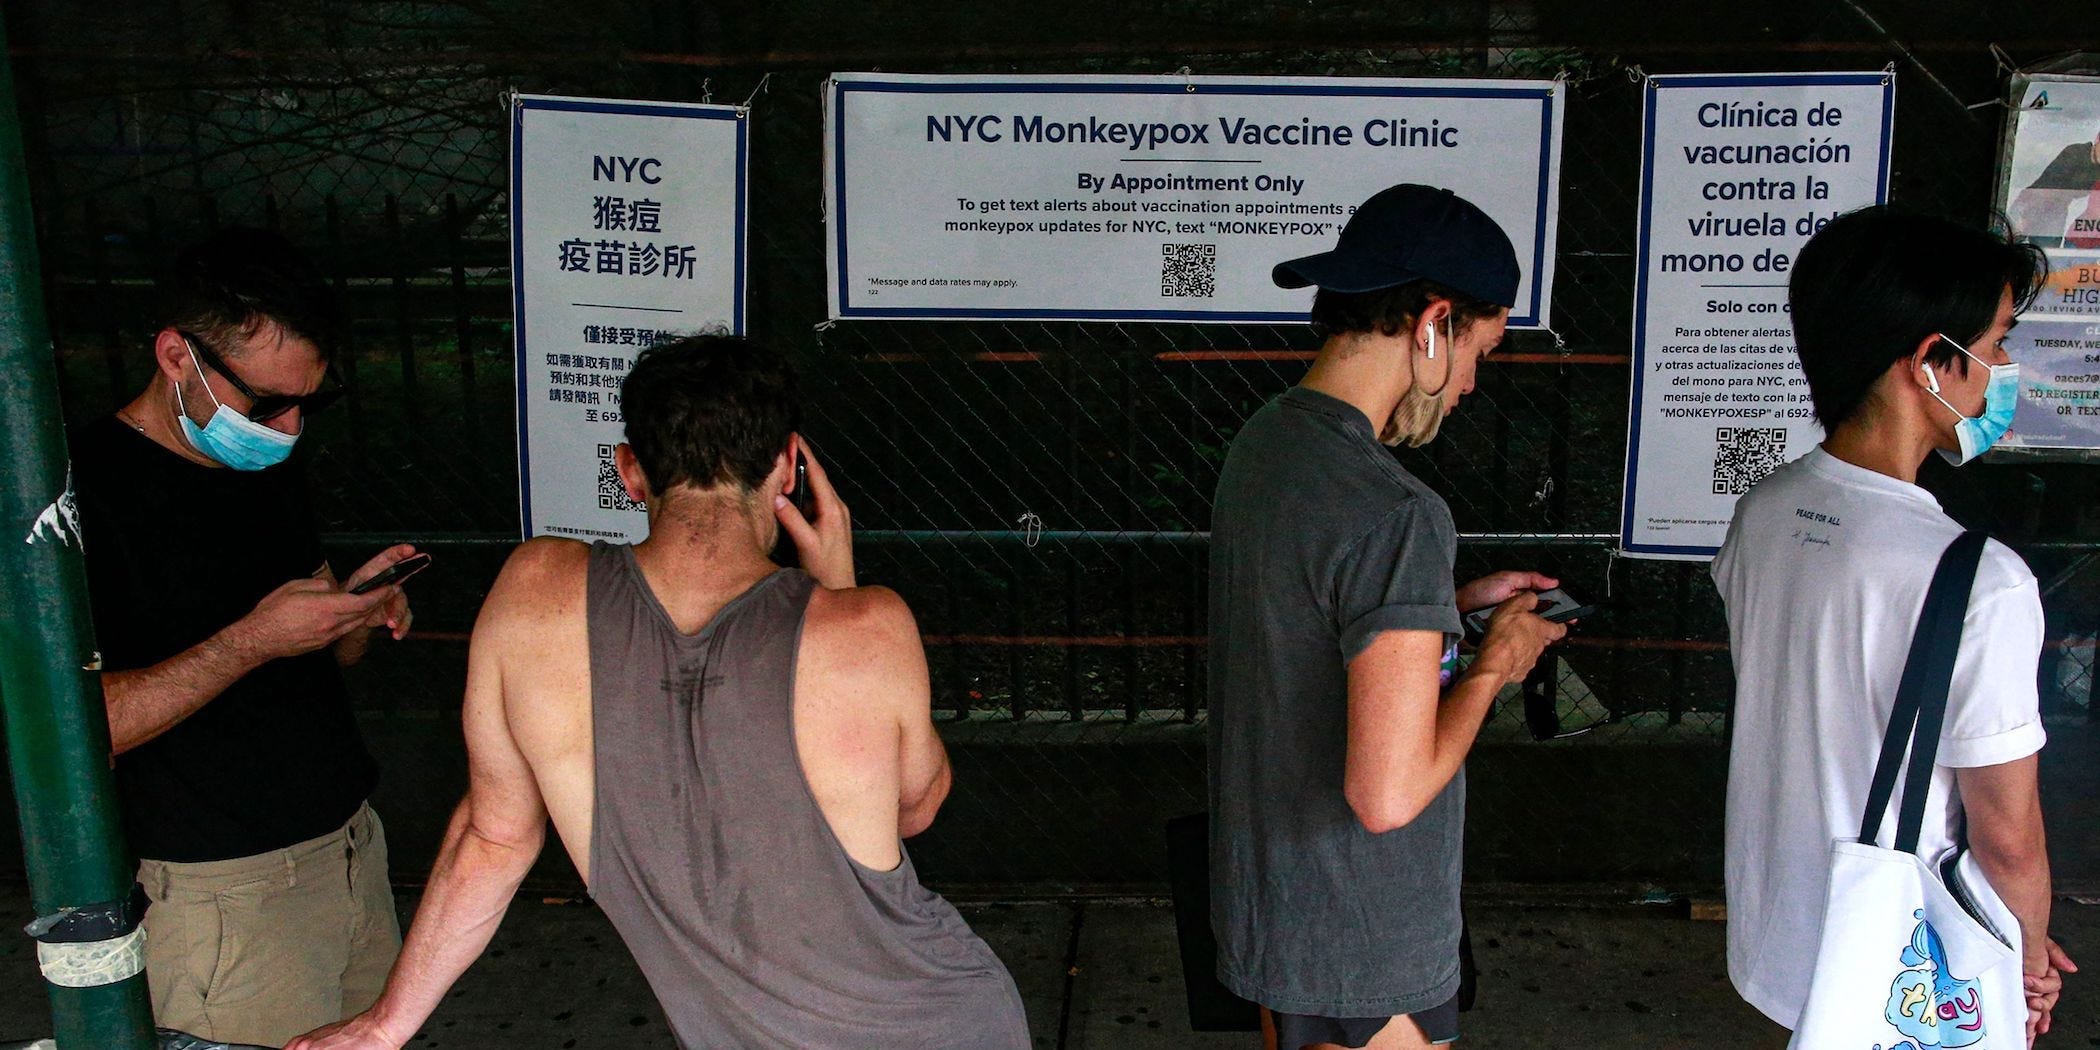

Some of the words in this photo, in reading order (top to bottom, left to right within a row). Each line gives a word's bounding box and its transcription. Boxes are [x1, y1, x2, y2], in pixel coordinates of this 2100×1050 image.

[1698, 102, 1797, 128] Clínica
[1807, 102, 1842, 127] de
[927, 115, 1001, 143] NYC
[1013, 115, 1209, 151] Monkeypox
[1219, 117, 1353, 146] Vaccine
[1363, 119, 1459, 148] Clinic
[1683, 138, 1850, 163] vacunación
[593, 155, 662, 184] NYC
[1077, 173, 1104, 193] By
[1110, 173, 1248, 194] Appointment
[1255, 175, 1304, 195] Only
[1702, 177, 1795, 200] contra
[1806, 176, 1829, 199] la
[593, 196, 661, 233] 猴痘
[957, 198, 975, 212] To
[980, 199, 1005, 216] get
[1009, 199, 1039, 212] text
[1044, 198, 1087, 213] alerts
[1092, 198, 1137, 213] about
[1141, 198, 1230, 214] vaccination
[1235, 201, 1343, 220] appointments
[945, 219, 1034, 235] monkeypox
[1039, 219, 1101, 235] updates
[1105, 219, 1127, 233] for
[1132, 220, 1171, 235] NYC,
[1176, 220, 1205, 233] text
[1209, 221, 1332, 236] “MONKEYPOX”
[1688, 212, 1786, 236] viruela
[558, 238, 697, 279] 疫苗診所
[1661, 253, 1744, 272] mono
[1753, 248, 1790, 272] de
[911, 278, 927, 286] and
[929, 278, 948, 286] data
[993, 279, 1018, 288] apply.
[1706, 301, 1743, 313] Solo
[1747, 303, 1777, 313] con
[1675, 328, 1700, 337] Para
[1704, 327, 1748, 337] obtener
[1752, 327, 1791, 337] alertas
[1662, 345, 1699, 353] acerca
[1702, 344, 1717, 354] de
[1720, 344, 1735, 354] las
[1739, 344, 1766, 353] citas
[1769, 344, 1784, 353] de
[2034, 339, 2082, 349] TUESDAY,
[546, 353, 624, 371] 如需獲取有關
[1655, 363, 1662, 371] y
[1665, 361, 1693, 370] otras
[1697, 360, 1784, 370] actualizaciones
[1672, 376, 1689, 386] del
[1693, 378, 1724, 386] mono
[1728, 378, 1753, 389] para
[1757, 377, 1785, 387] NYC,
[1788, 378, 1808, 386] env
[1664, 394, 1711, 404] mensaje
[1714, 392, 1729, 402] de
[1732, 393, 1760, 402] texto
[1763, 394, 1784, 402] con
[1787, 393, 1796, 402] la
[2029, 389, 2043, 398] TO
[2046, 389, 2099, 399] REGISTER
[586, 409, 598, 422] 至
[1661, 408, 1771, 418] "MONKEYPOXESP"
[1774, 409, 1784, 418] al
[1787, 408, 1816, 418] 692-
[2057, 406, 2072, 415] OR
[1796, 508, 1814, 520] PEACE
[1827, 517, 1840, 526] ALL
